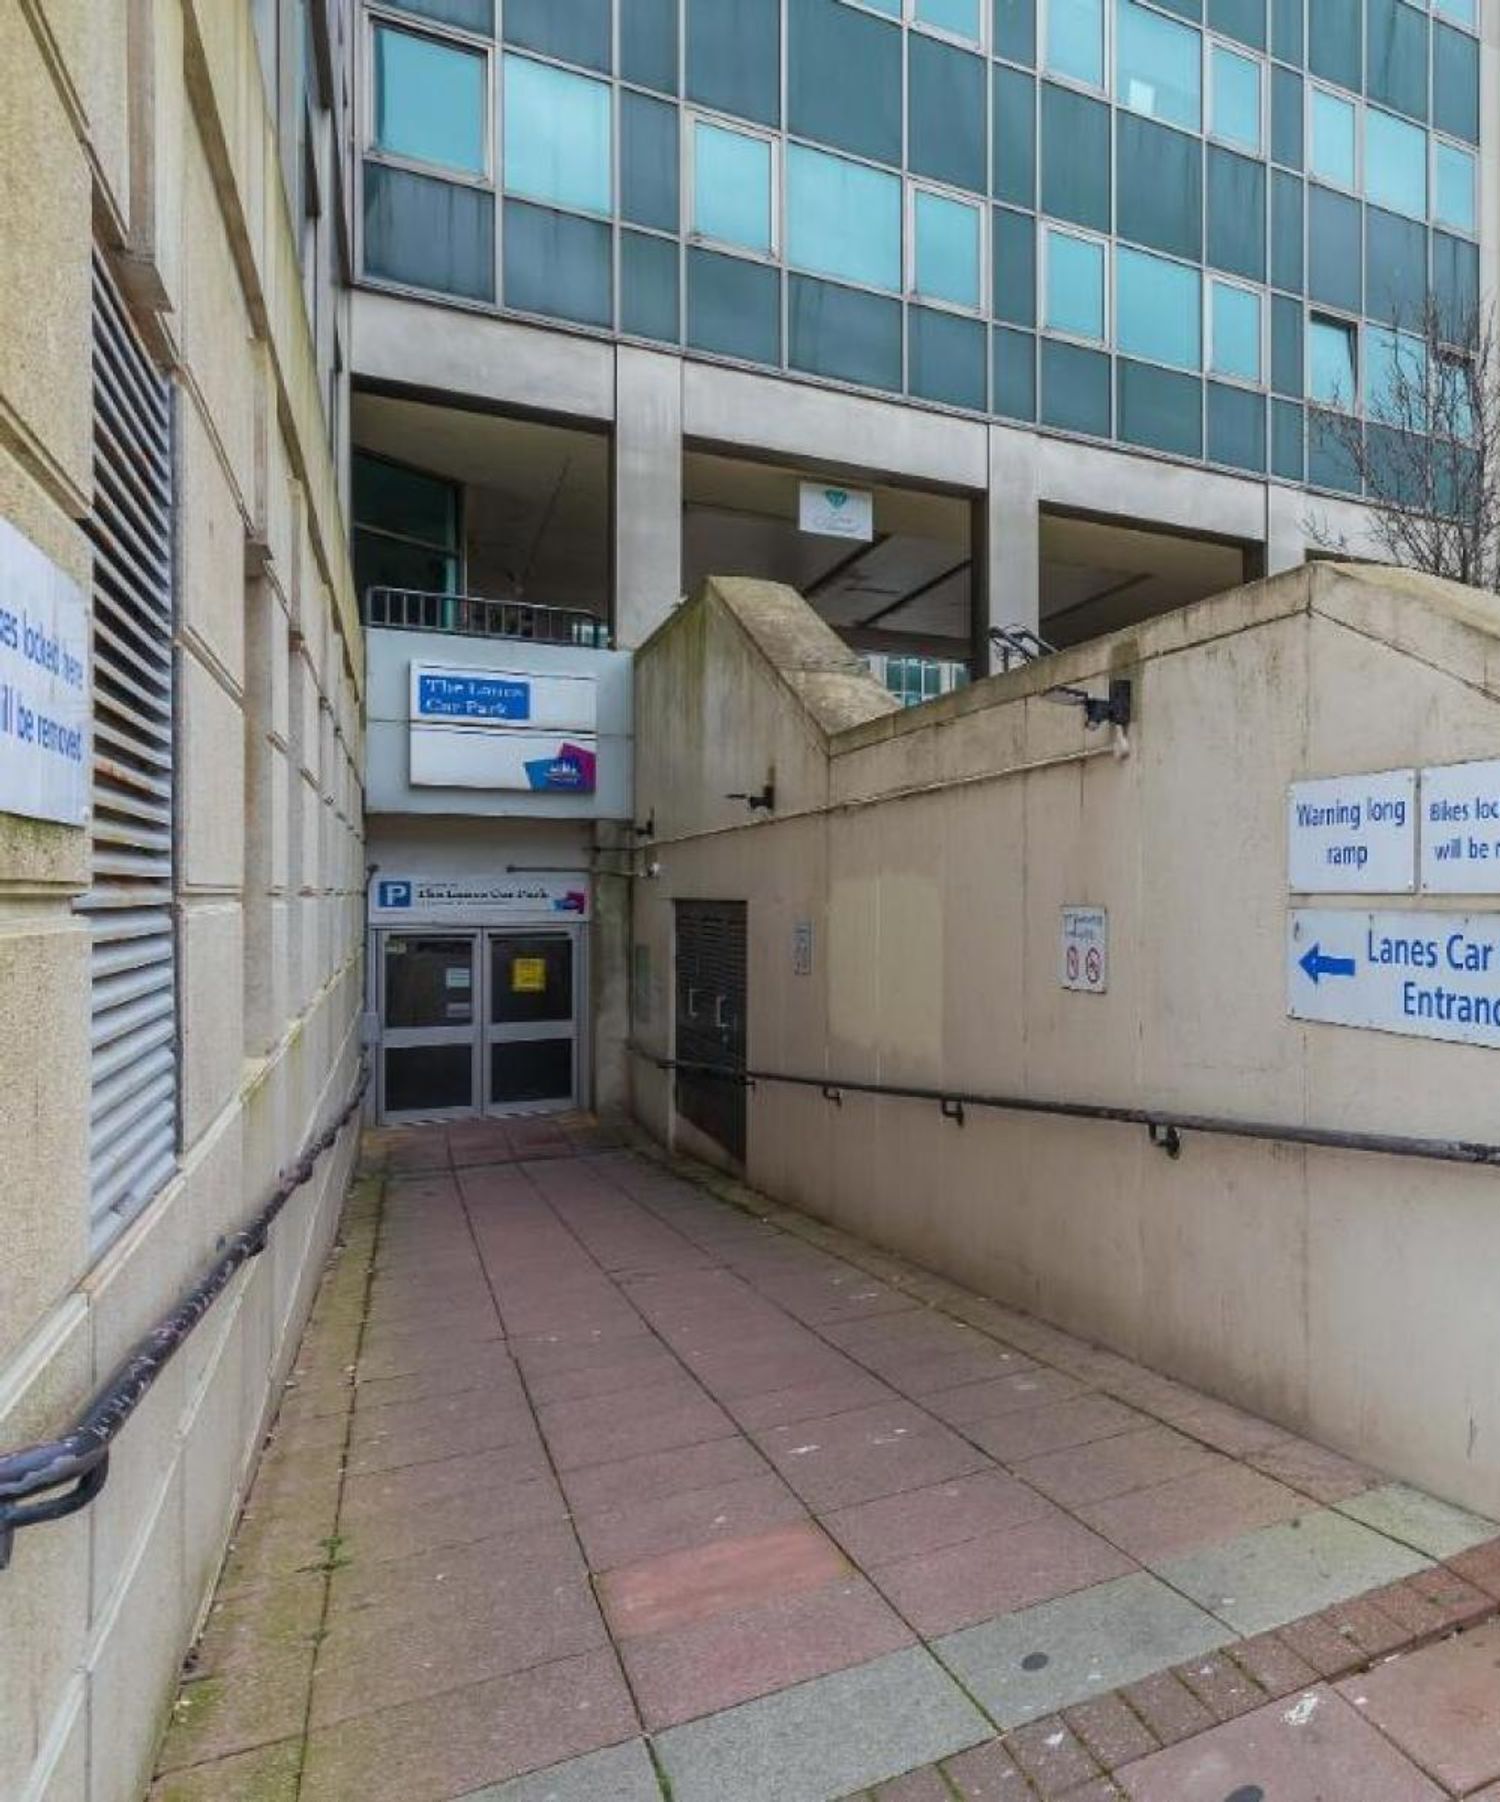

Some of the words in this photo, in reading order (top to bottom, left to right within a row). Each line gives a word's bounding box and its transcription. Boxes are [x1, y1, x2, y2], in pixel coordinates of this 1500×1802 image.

[24, 609, 59, 675] locked
[427, 679, 464, 695] The
[470, 683, 524, 697] Lanes
[426, 700, 461, 714] Car
[466, 701, 506, 714] Park
[17, 690, 33, 743] be
[38, 714, 82, 763] removed
[1297, 804, 1360, 829] Warning
[1367, 796, 1405, 826] long
[1430, 803, 1469, 822] Bikes
[1327, 844, 1368, 869] ramp
[1434, 838, 1462, 861] will
[1469, 836, 1489, 859] be
[387, 885, 406, 905] P
[1367, 929, 1438, 969] Lanes
[1446, 934, 1494, 972] Car
